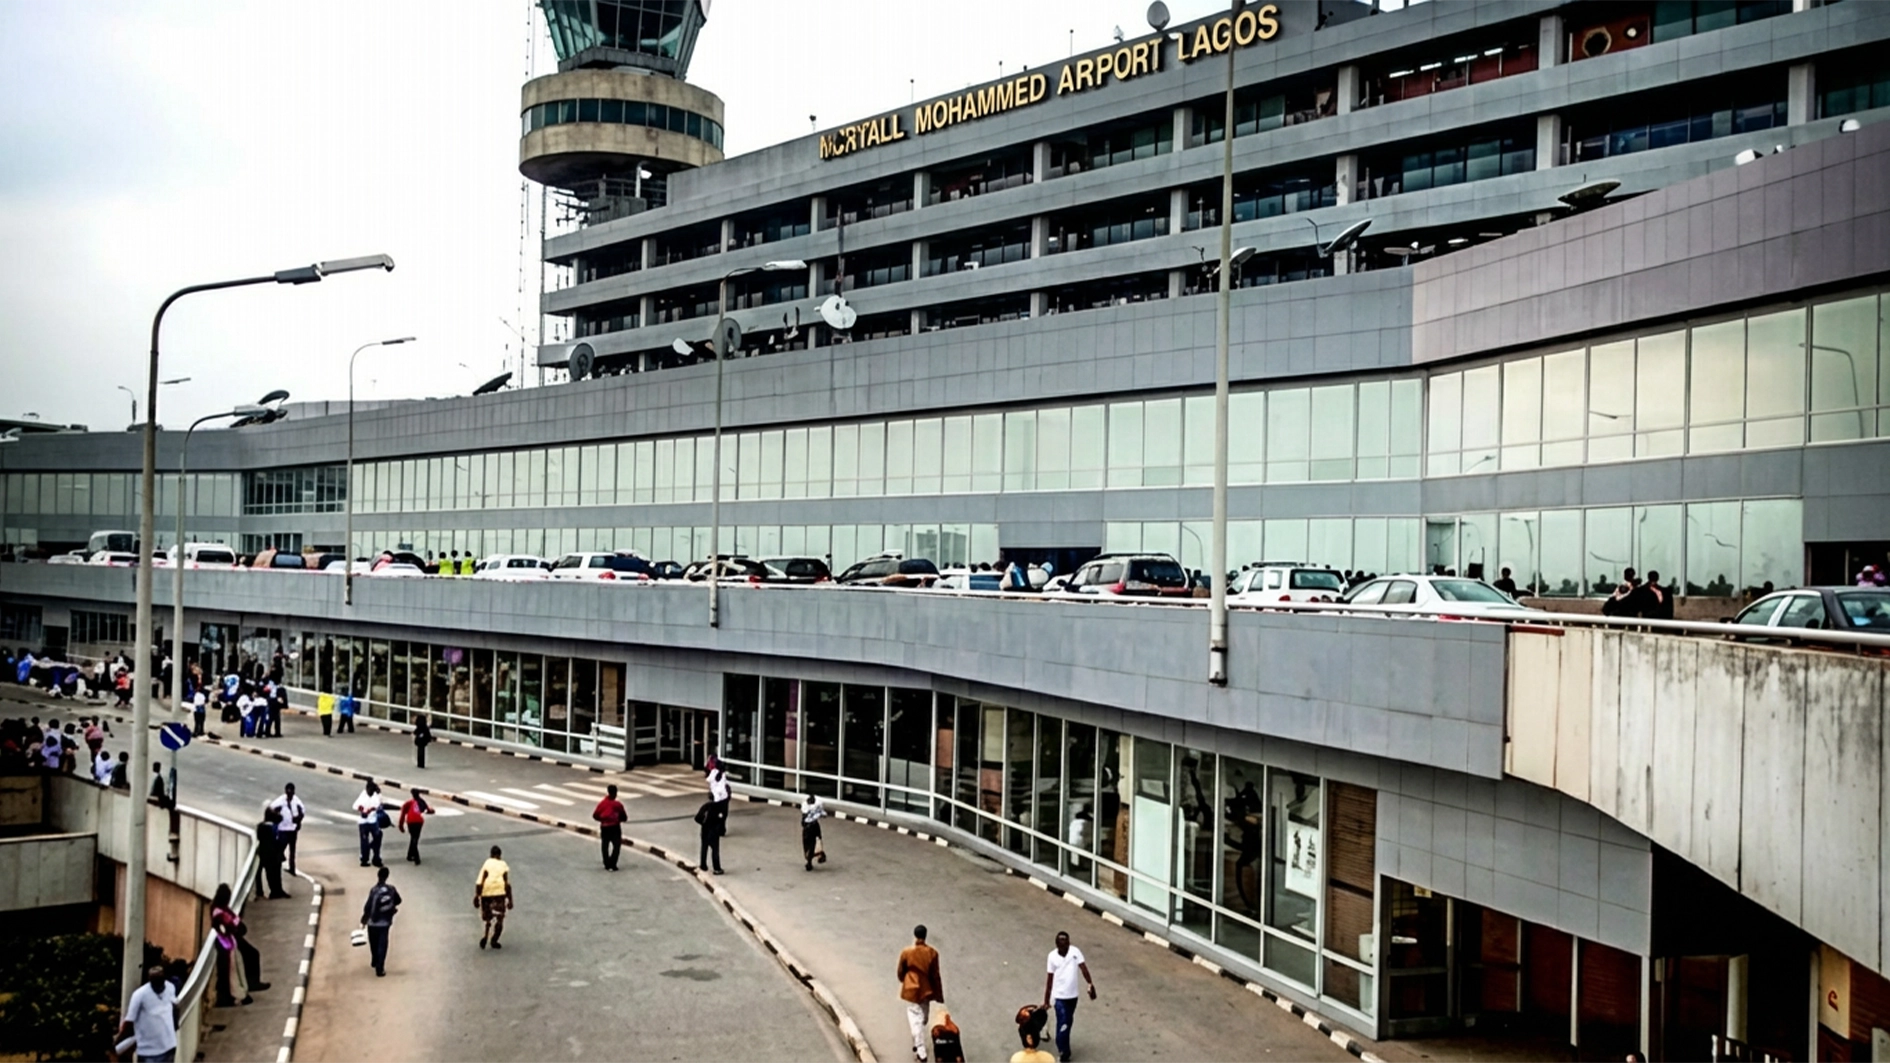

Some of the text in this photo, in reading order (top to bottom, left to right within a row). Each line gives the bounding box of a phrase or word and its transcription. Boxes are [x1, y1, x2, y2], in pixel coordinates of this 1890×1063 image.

[915, 73, 1046, 134] MOHAMMED
[1057, 38, 1163, 95] ARPORT
[1176, 4, 1278, 61] LAGOS
